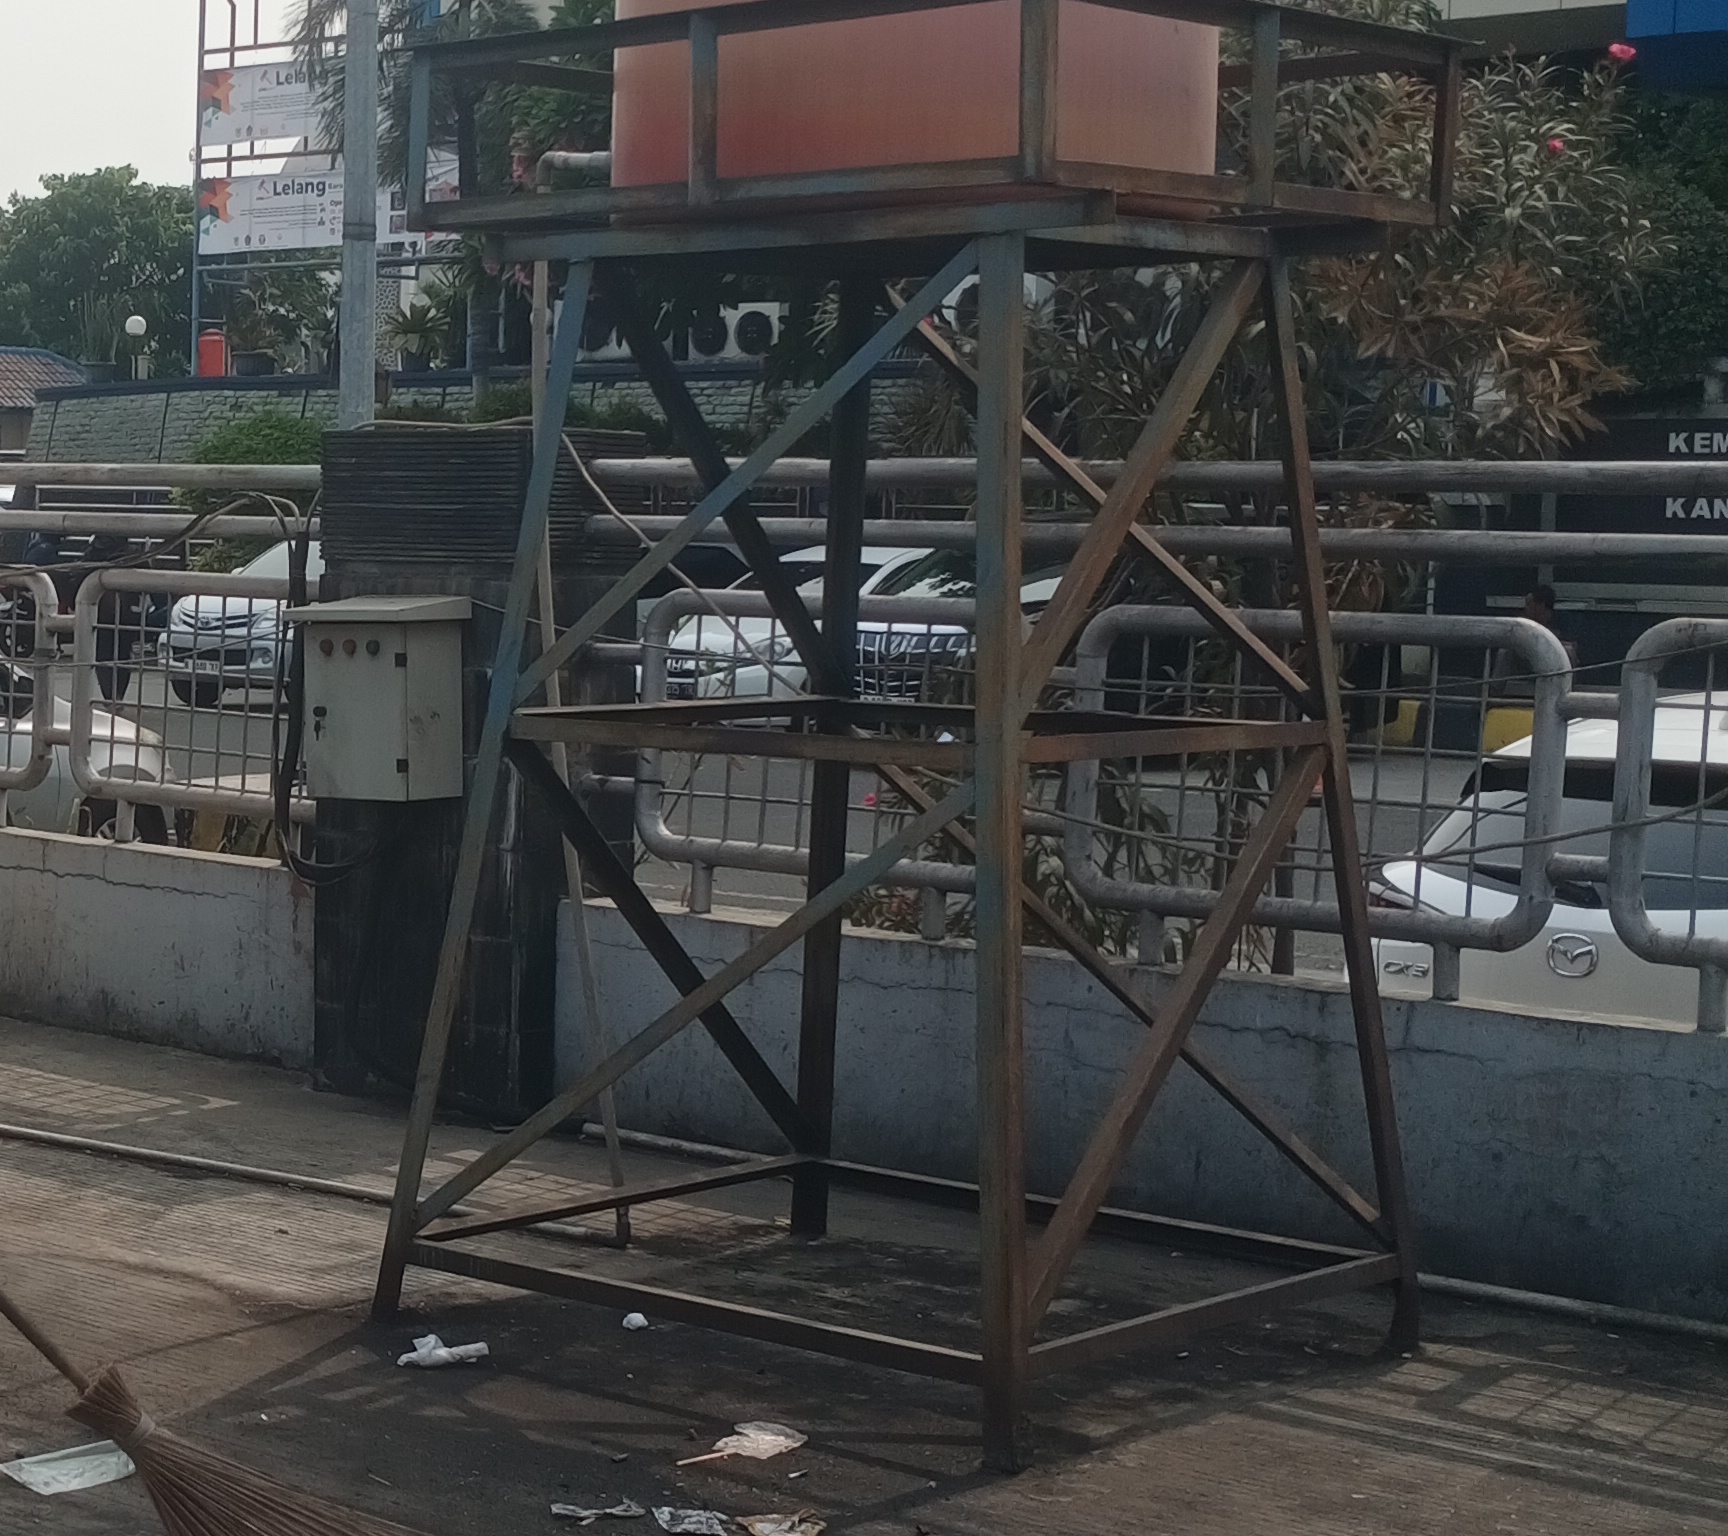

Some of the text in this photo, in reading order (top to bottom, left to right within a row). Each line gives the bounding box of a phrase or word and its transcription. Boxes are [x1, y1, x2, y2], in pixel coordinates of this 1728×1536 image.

[276, 70, 308, 86] Lela
[273, 179, 326, 197] Lelang
[1668, 432, 1728, 453] KEM
[1665, 497, 1728, 519] KAN
